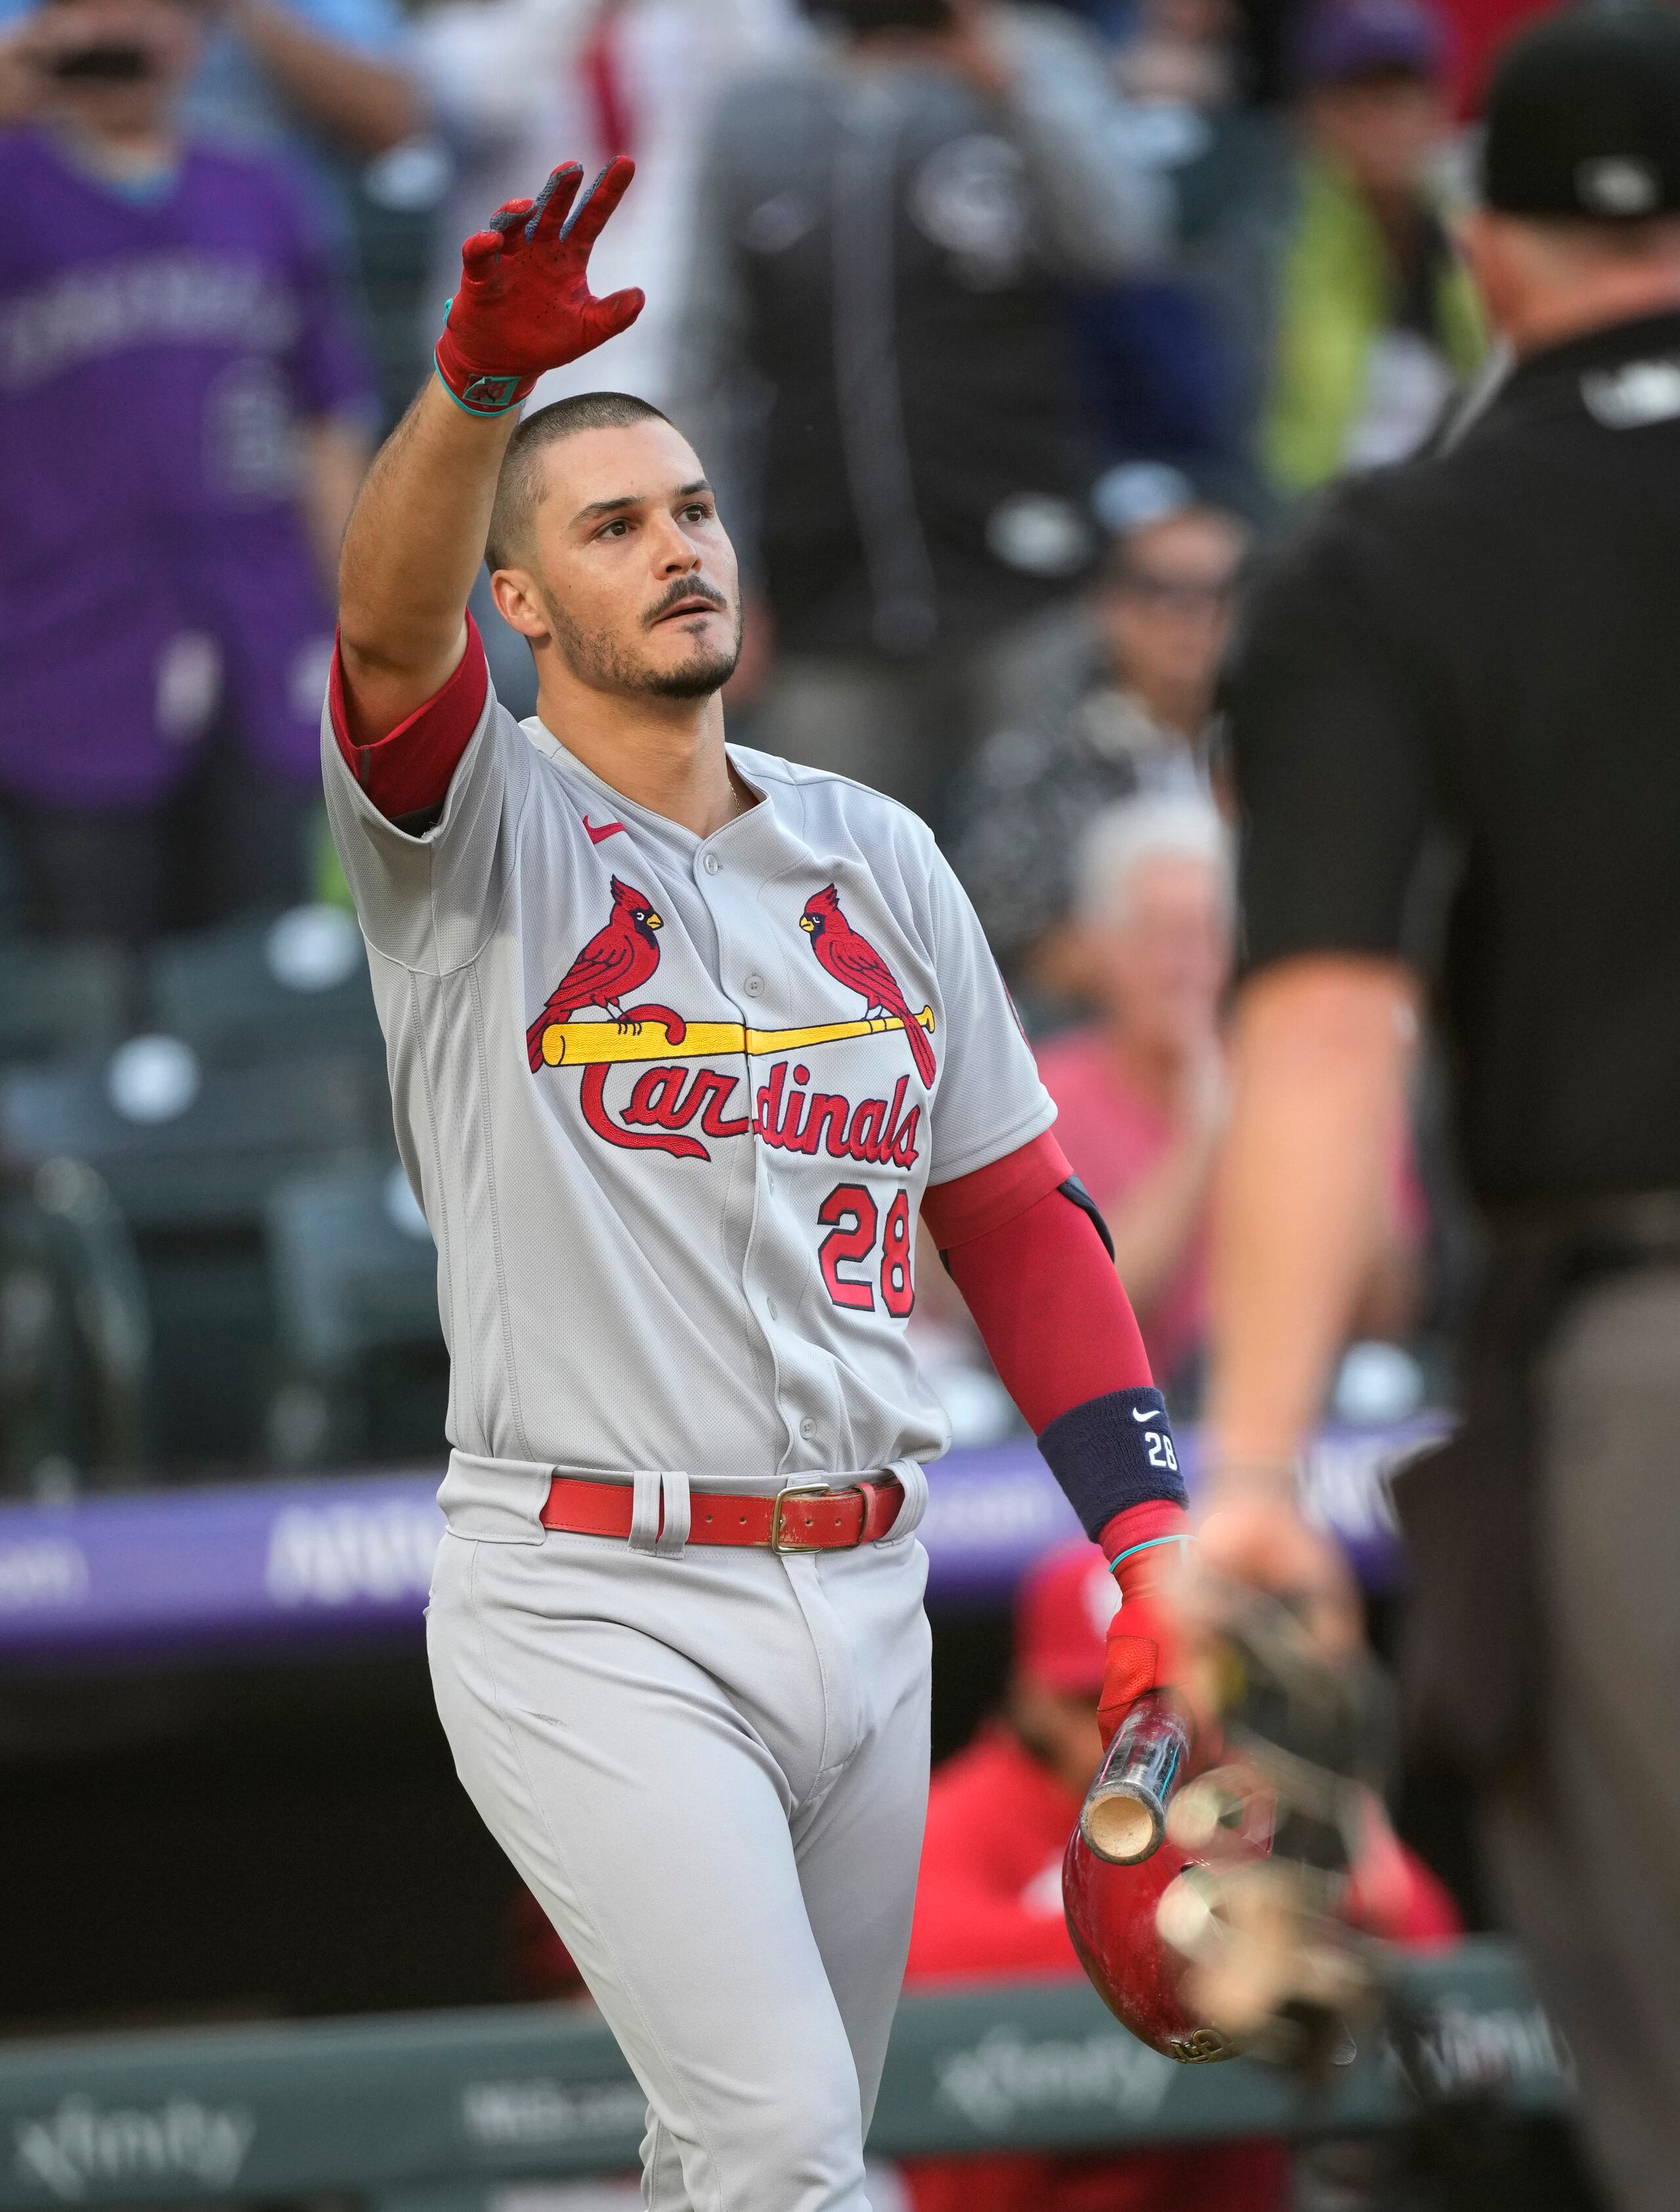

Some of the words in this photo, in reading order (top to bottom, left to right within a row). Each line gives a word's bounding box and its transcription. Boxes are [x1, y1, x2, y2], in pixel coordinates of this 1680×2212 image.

[579, 1003, 921, 1171] Cardinals
[817, 1182, 915, 1318] 28
[1144, 1432, 1178, 1471] 28
